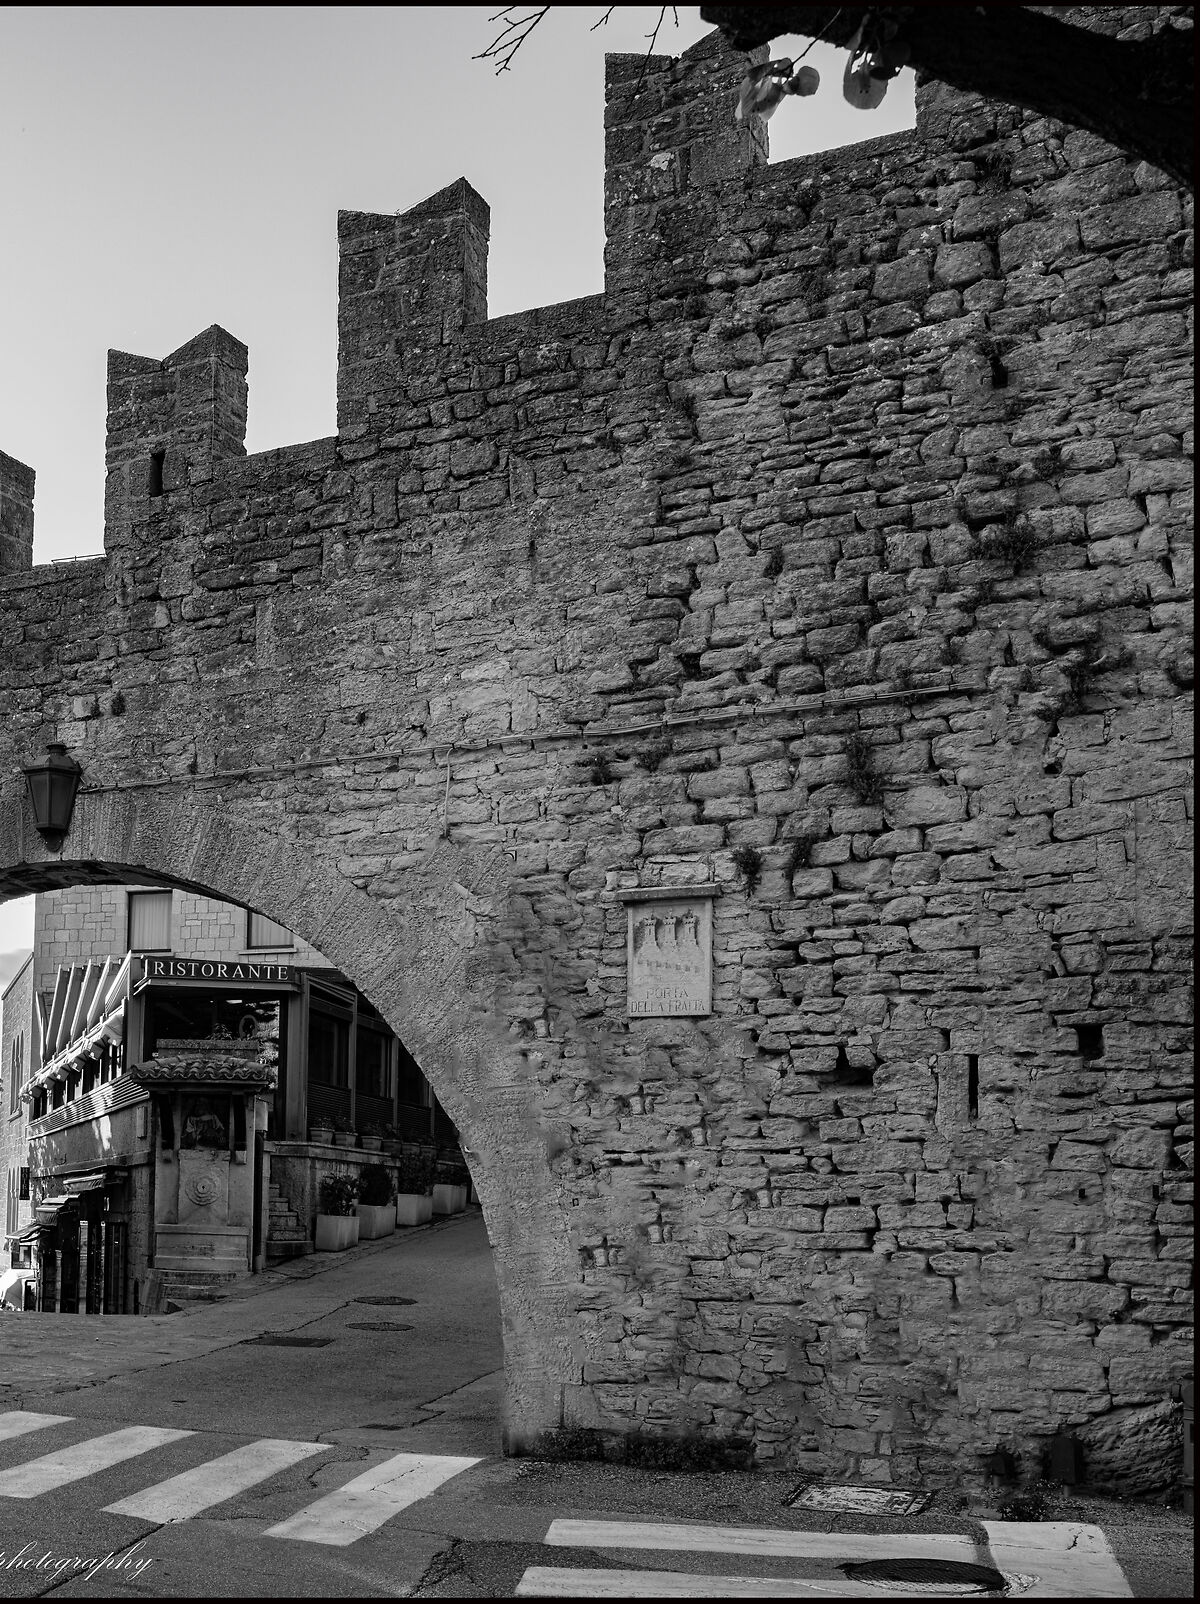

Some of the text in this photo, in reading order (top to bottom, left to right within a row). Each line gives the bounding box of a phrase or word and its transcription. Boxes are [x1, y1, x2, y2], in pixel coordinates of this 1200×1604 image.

[153, 961, 289, 981] RISTORANTE
[646, 987, 688, 999] PORTA
[631, 1000, 705, 1012] DELLA FRATTA
